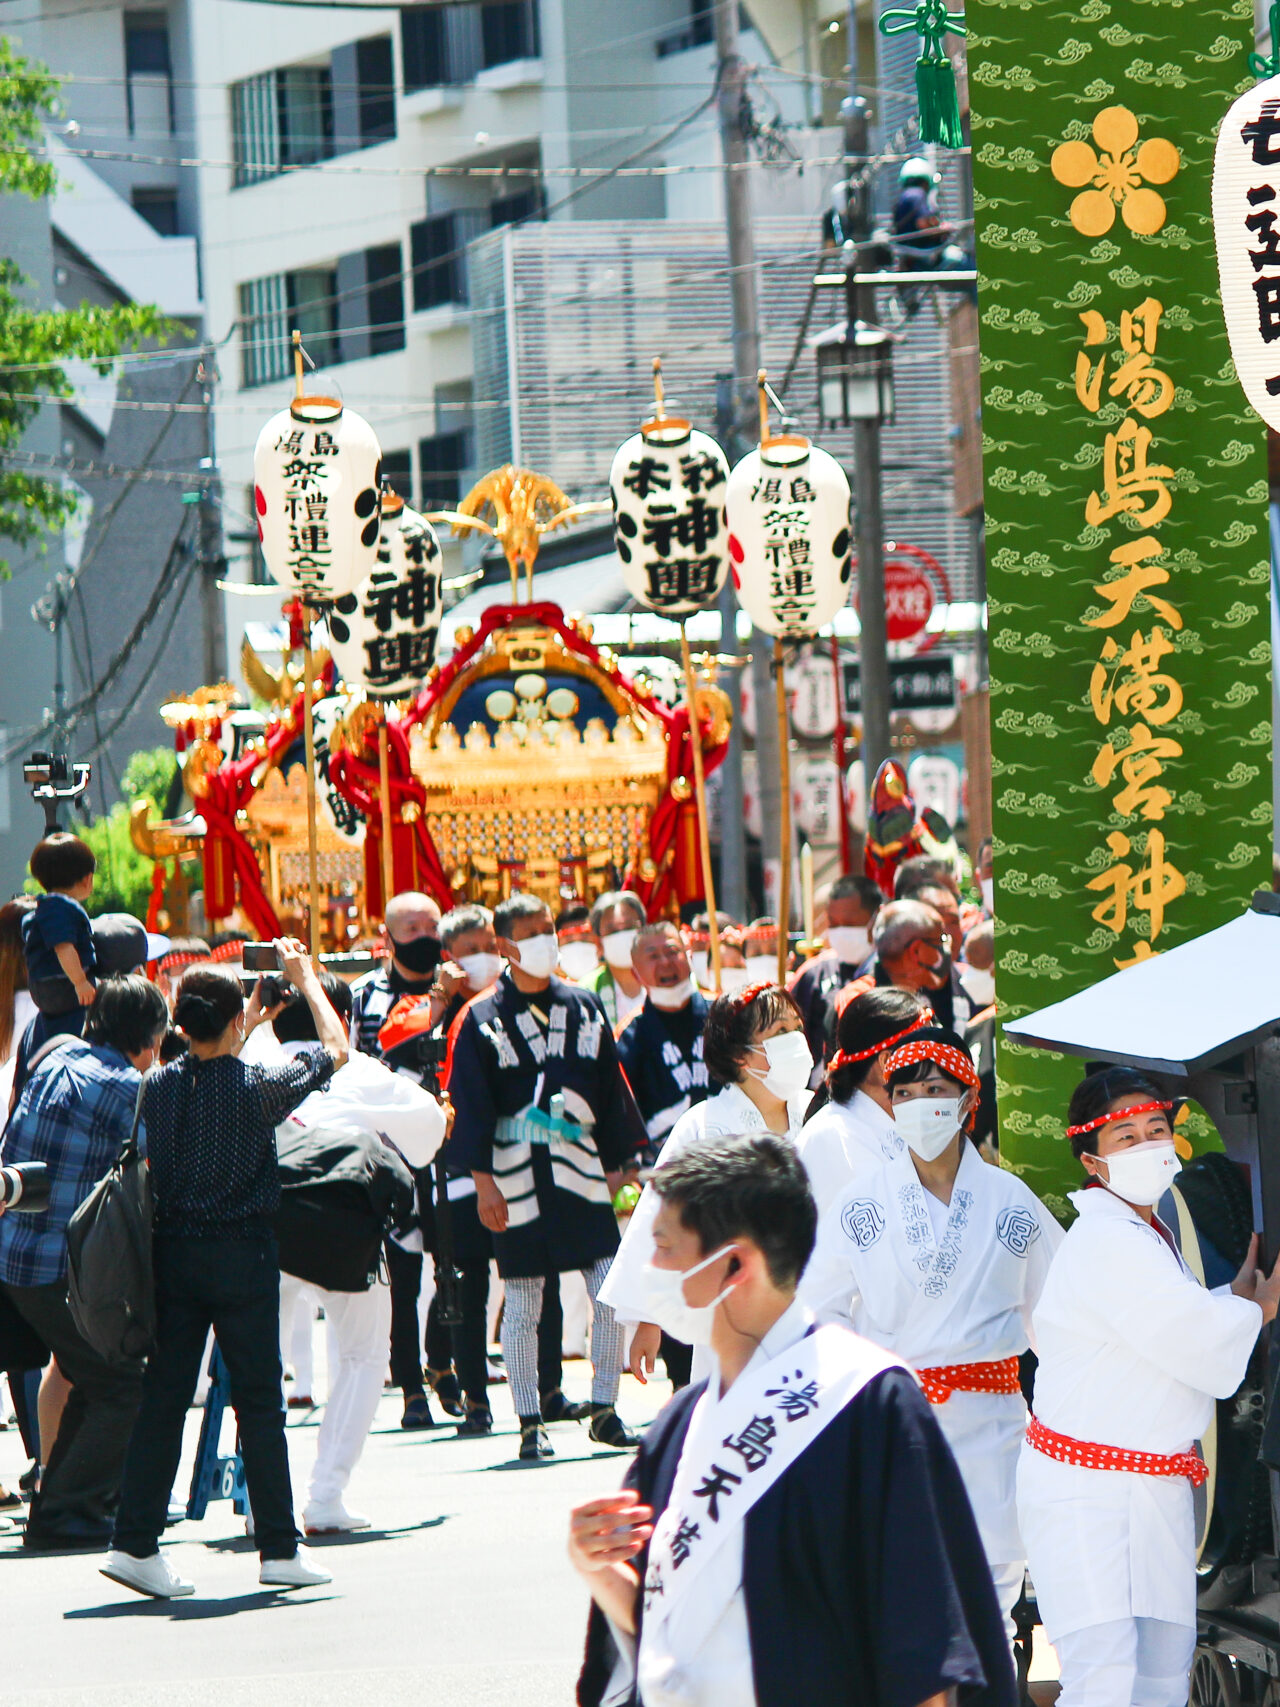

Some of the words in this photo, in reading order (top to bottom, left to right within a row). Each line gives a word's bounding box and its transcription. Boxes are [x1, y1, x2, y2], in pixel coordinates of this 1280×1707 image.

[275, 431, 340, 457] 湯島
[623, 450, 728, 500] 本社
[751, 477, 817, 503] 湯島
[1074, 296, 1188, 970] 湯島天満宮神
